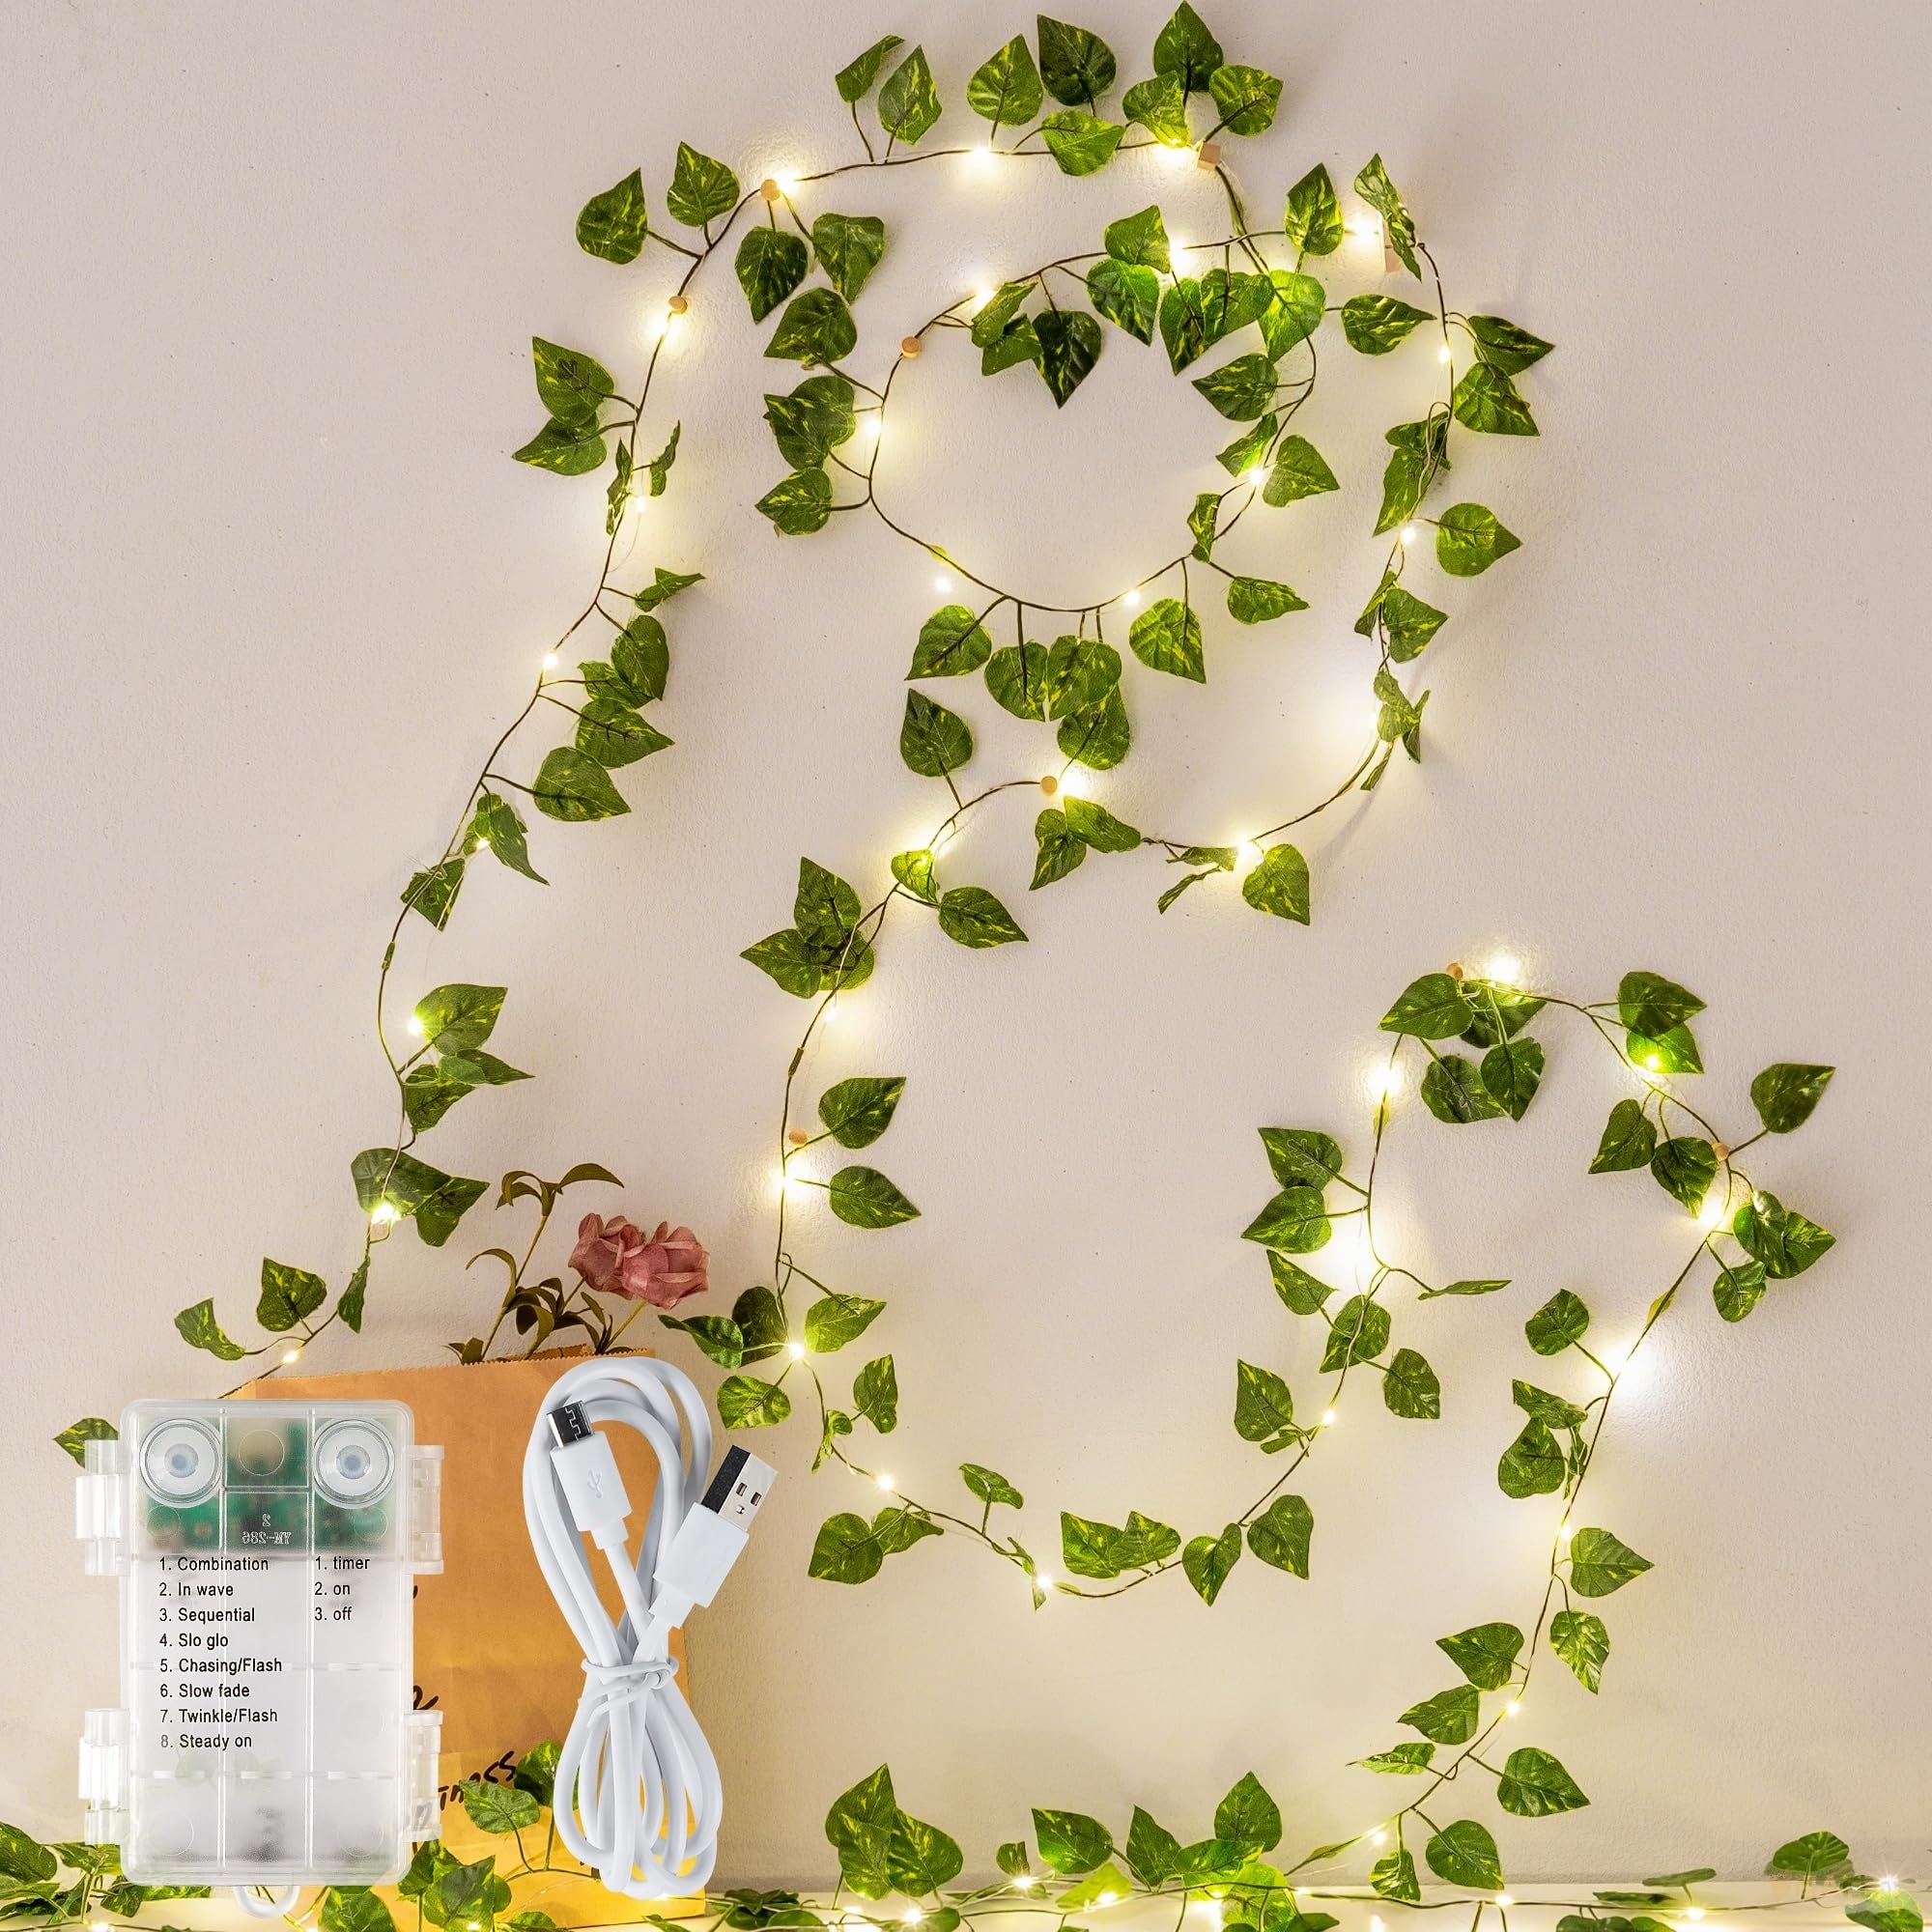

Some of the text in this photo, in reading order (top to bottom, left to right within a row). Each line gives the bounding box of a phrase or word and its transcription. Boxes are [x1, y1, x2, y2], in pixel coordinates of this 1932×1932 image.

[159, 1556, 269, 1571] 1. Combination
[315, 1555, 371, 1570] 1. timer
[158, 1581, 234, 1597] 2. In wave
[314, 1581, 351, 1596] 2. on
[158, 1606, 255, 1625] 3. Sequential
[314, 1605, 353, 1621] 3. off
[159, 1633, 229, 1651] 4. Slo glo
[159, 1657, 282, 1676] 5. Chasing/Flash
[159, 1683, 250, 1698] 6. Slow fade
[160, 1708, 278, 1723] 7. Twinkle/Flash
[160, 1733, 252, 1751] 8. Steady on
